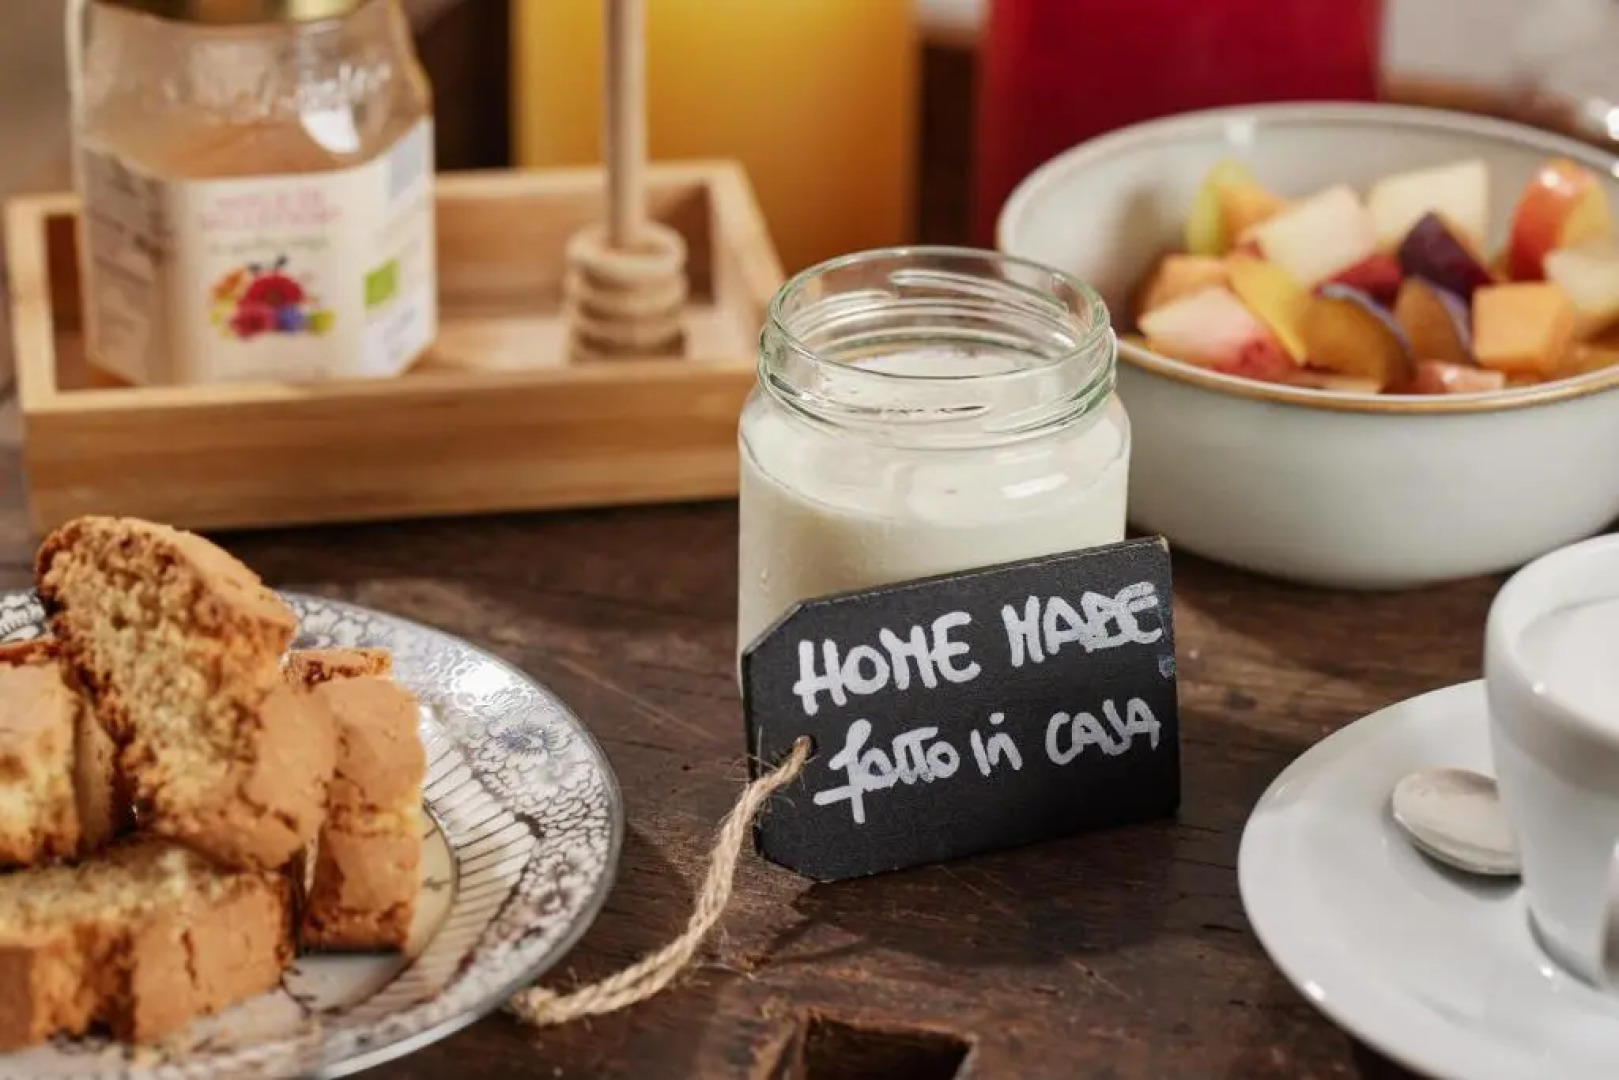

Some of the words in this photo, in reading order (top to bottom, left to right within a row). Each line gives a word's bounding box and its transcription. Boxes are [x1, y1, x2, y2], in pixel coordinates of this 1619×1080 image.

[793, 611, 981, 716] HOME
[1001, 581, 1163, 667] MADE
[1045, 697, 1161, 765] CASA
